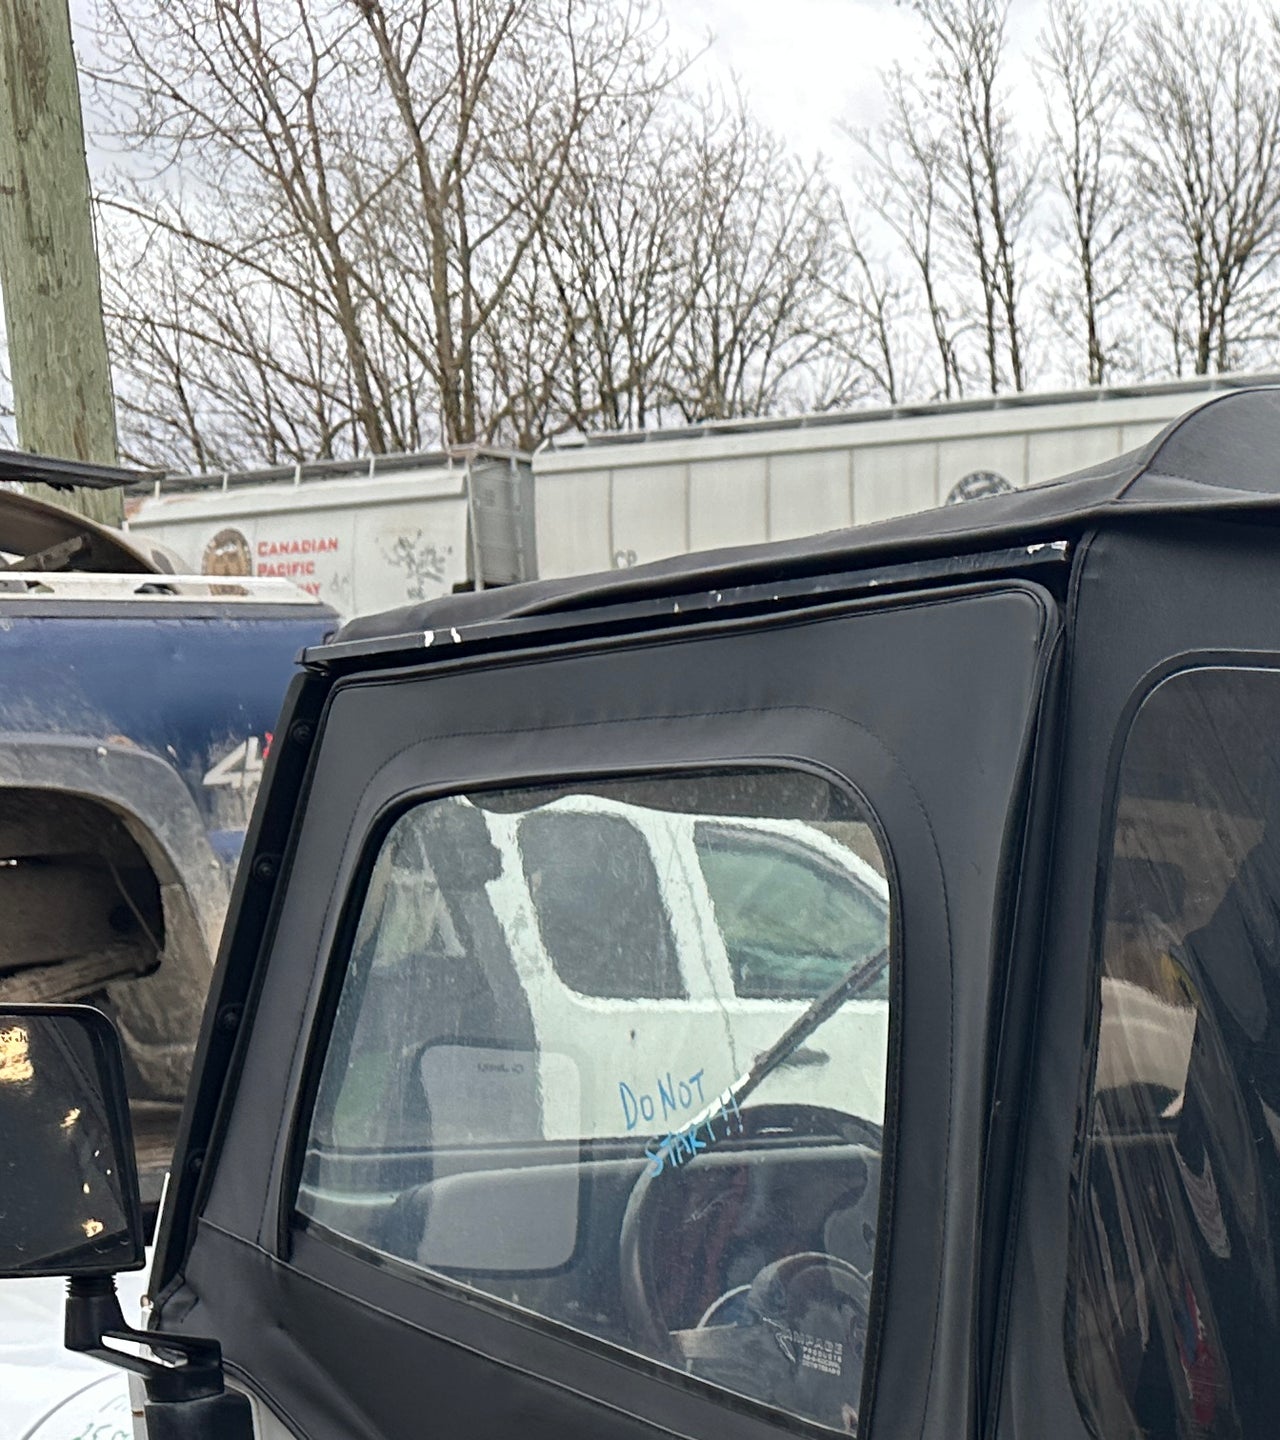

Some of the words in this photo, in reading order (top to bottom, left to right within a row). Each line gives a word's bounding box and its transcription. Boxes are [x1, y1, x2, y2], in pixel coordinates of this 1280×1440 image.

[257, 538, 339, 558] CANADIAN
[257, 561, 316, 578] PACIFIC
[657, 1068, 705, 1121] NOT
